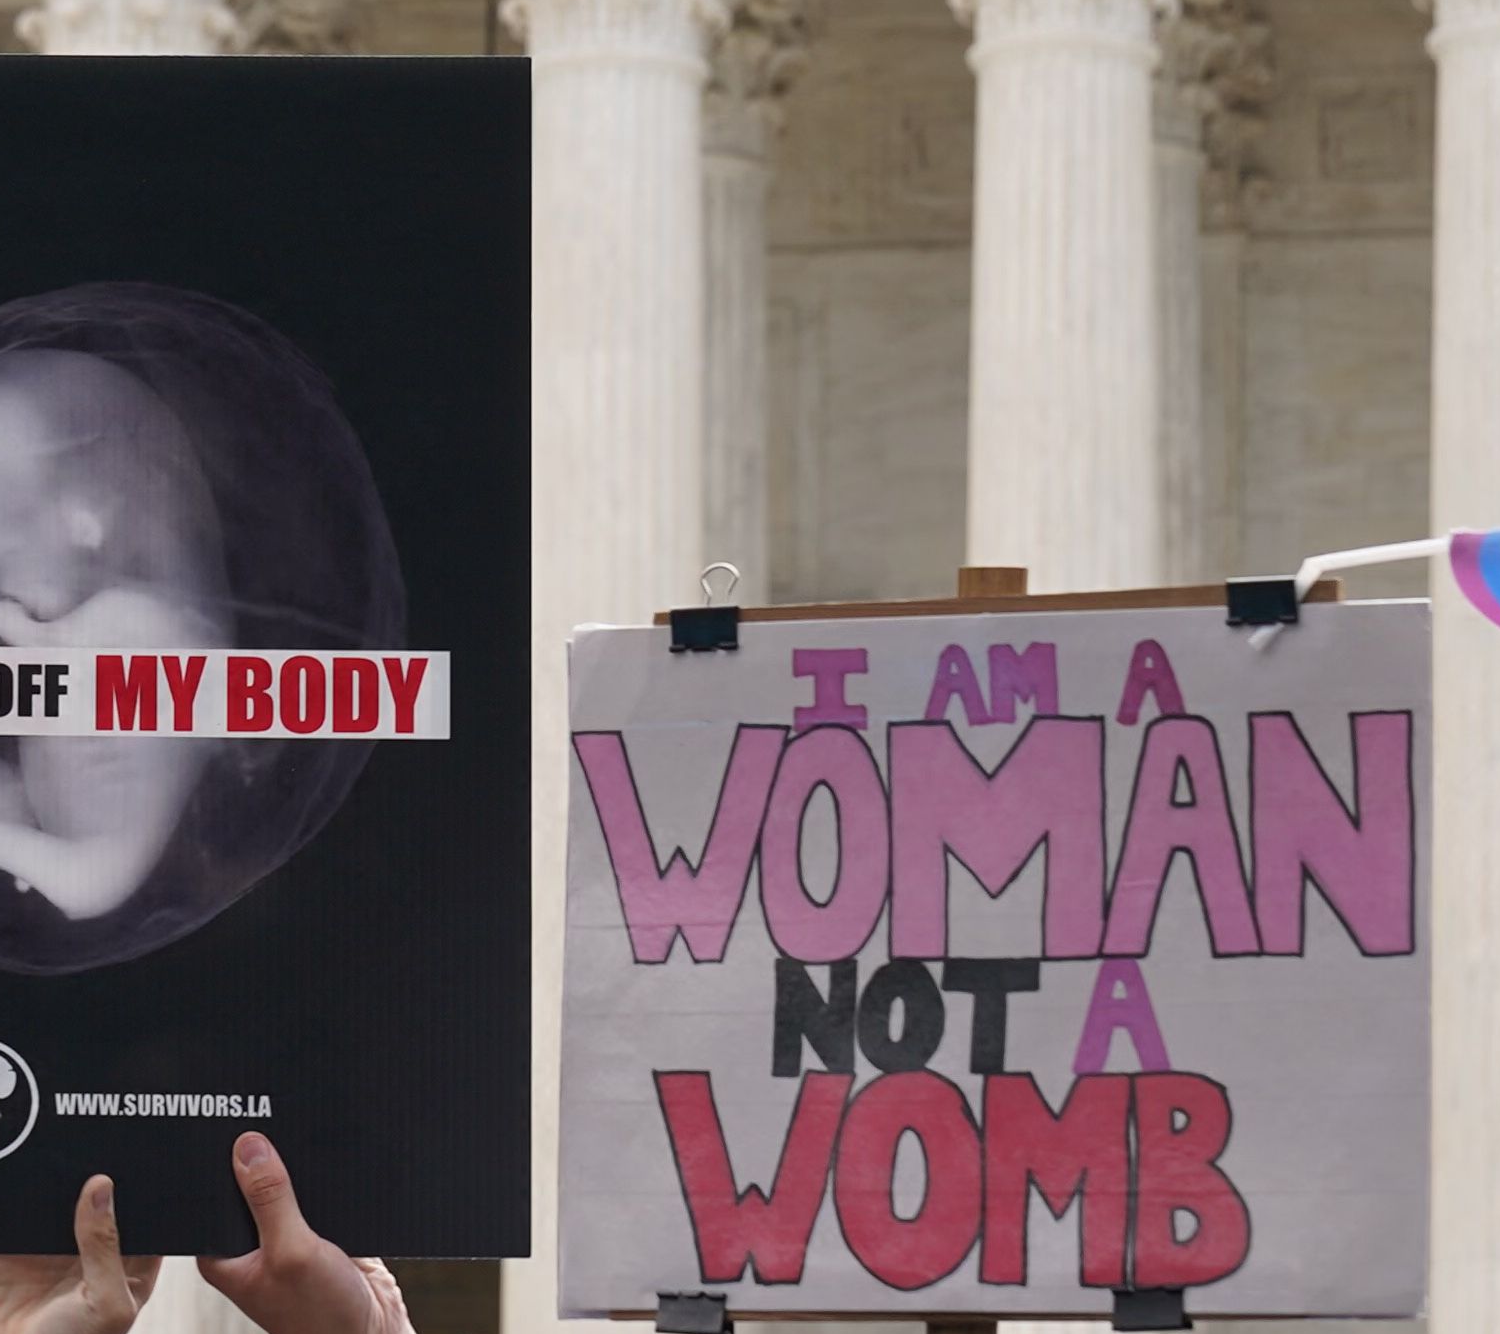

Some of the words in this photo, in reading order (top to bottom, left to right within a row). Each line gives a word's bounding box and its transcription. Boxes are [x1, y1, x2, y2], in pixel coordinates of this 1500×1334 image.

[94, 655, 208, 732] MY
[225, 656, 429, 735] BODY
[792, 648, 869, 729] I
[924, 642, 1059, 726] AM
[1117, 639, 1186, 725] A
[572, 709, 1415, 964] WOMAN
[771, 957, 1040, 1078] NOT
[1072, 957, 1172, 1074] A
[55, 1092, 272, 1118] WWW.SURVIVORS.LA
[652, 1069, 1251, 1291] WOMB
